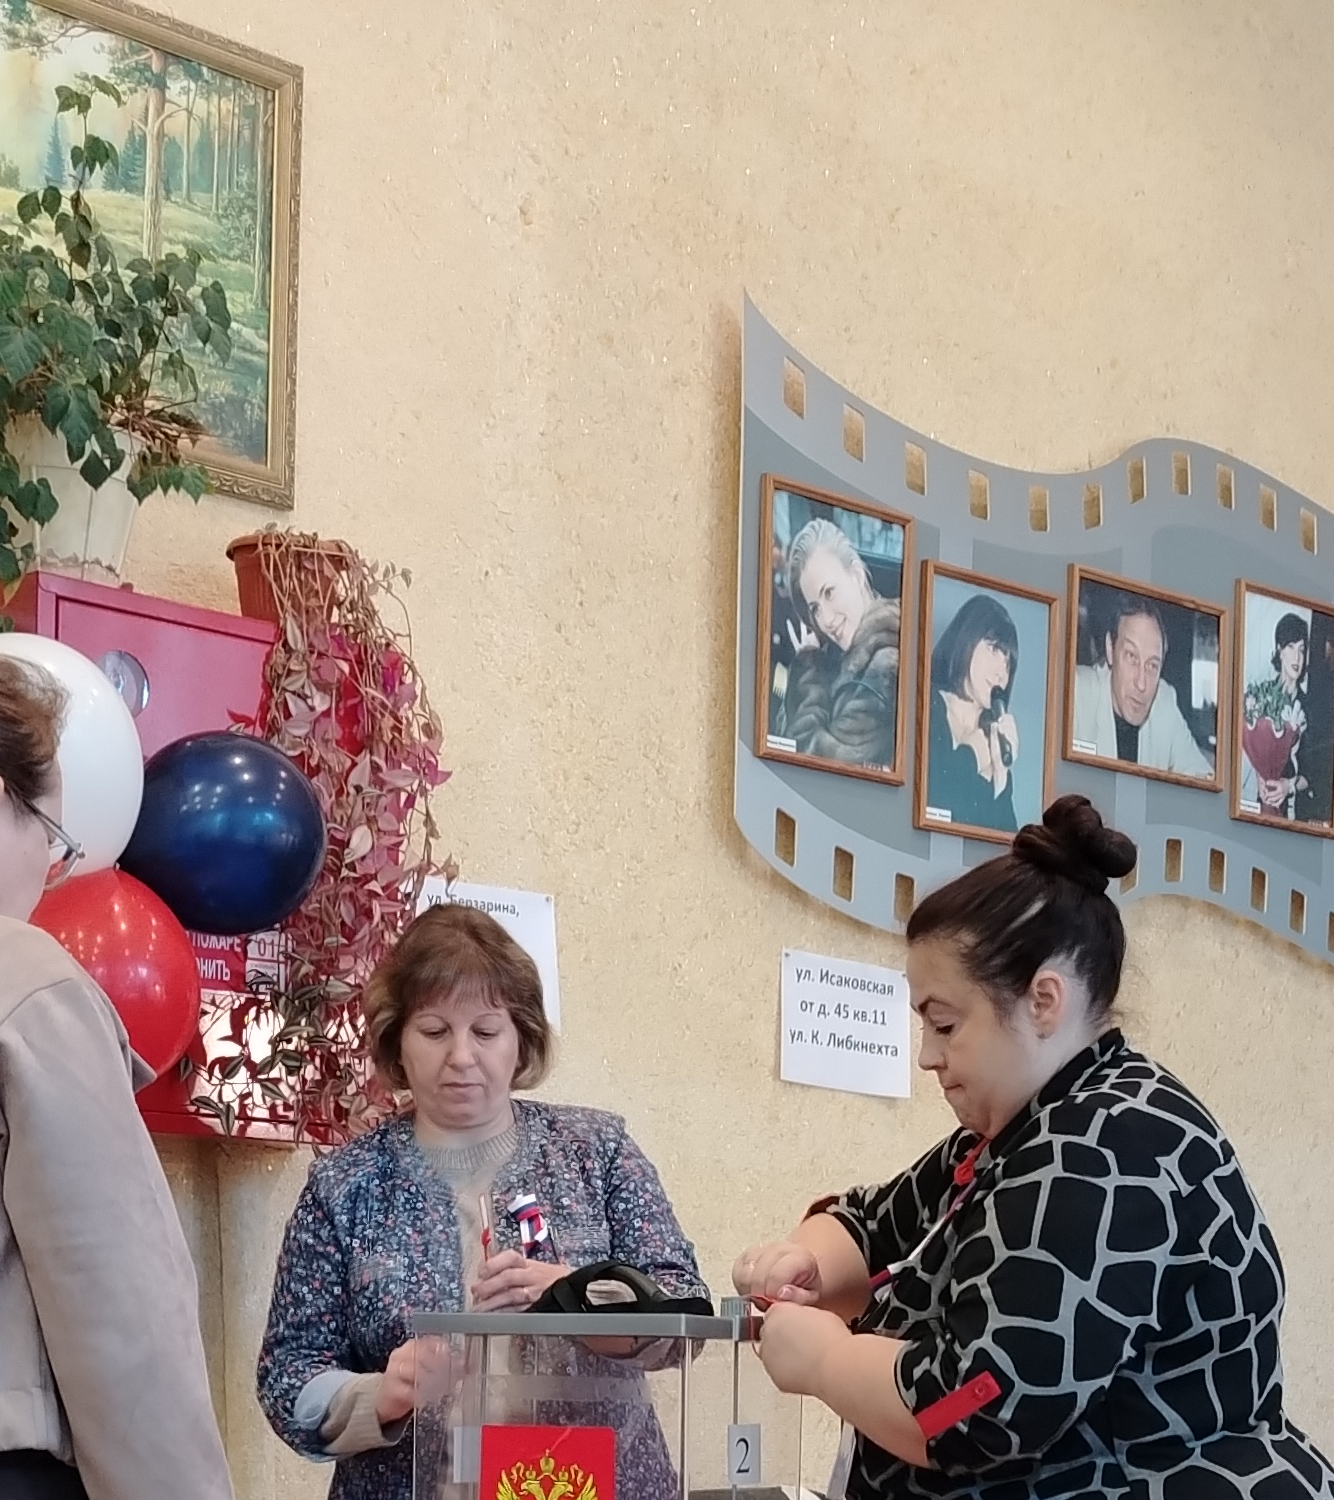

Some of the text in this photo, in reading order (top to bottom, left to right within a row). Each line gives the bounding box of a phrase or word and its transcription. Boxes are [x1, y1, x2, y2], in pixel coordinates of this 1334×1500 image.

[258, 937, 275, 959] 01
[196, 957, 231, 981] НИТЬ
[795, 967, 895, 997] ул. Исаковская
[800, 1000, 887, 1026] от д. 45 кв.11
[789, 1029, 899, 1058] ул. К. Либкнехта
[735, 1437, 750, 1474] 2
